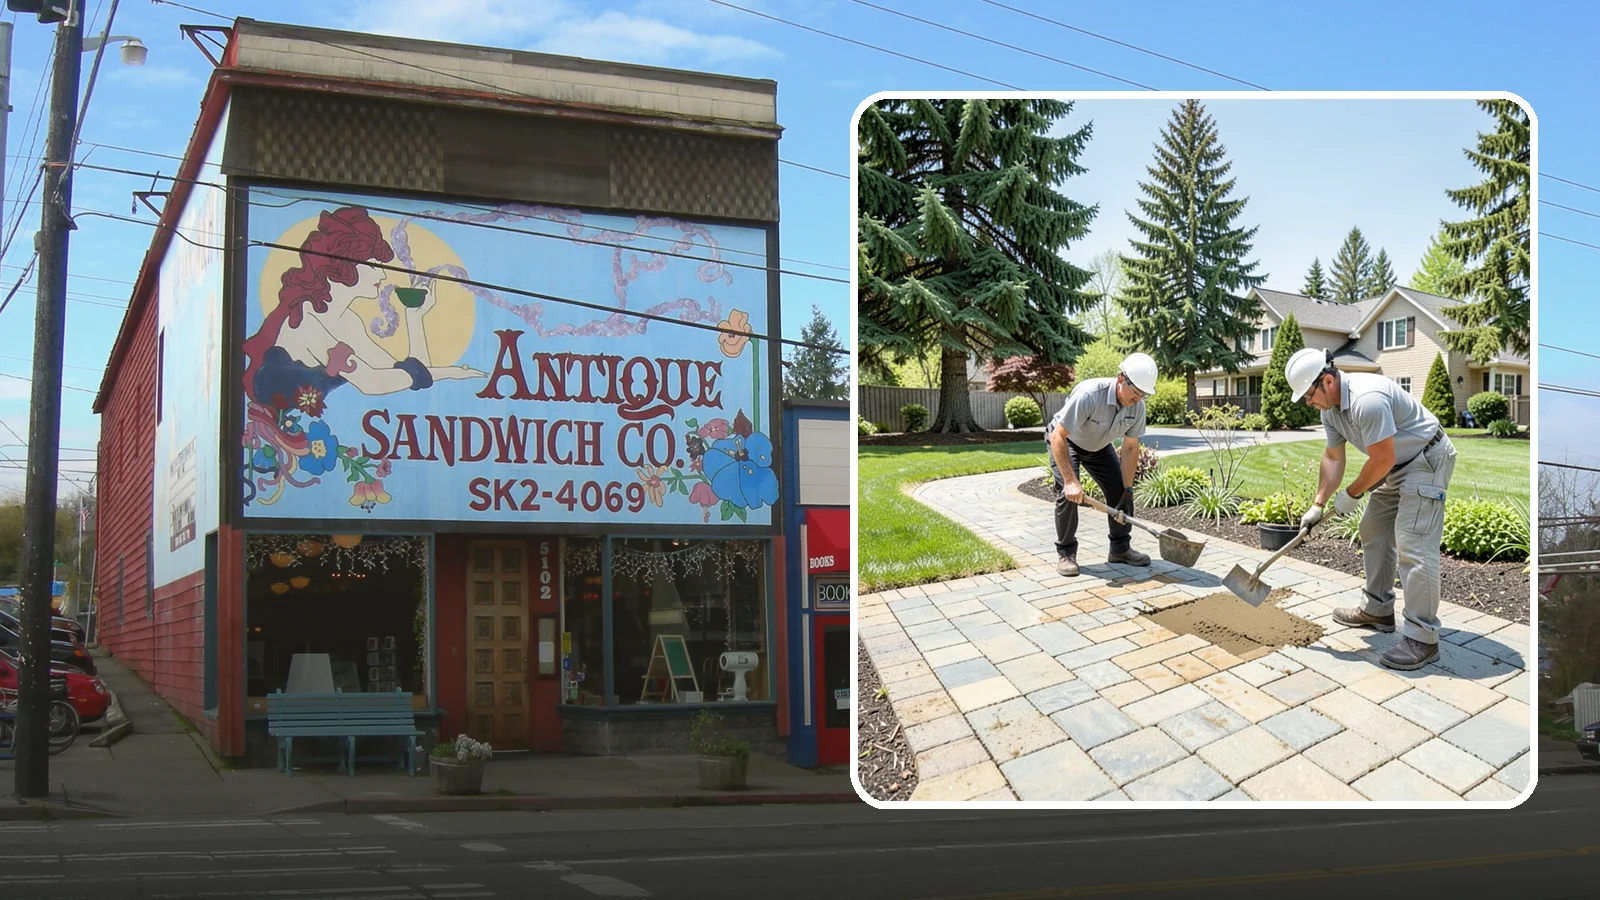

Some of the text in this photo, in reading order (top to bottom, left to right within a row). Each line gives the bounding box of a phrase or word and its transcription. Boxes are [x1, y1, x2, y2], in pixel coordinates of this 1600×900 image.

[476, 329, 724, 420] ANTIQUE
[361, 408, 685, 469] SANDWICH CO.
[468, 477, 646, 514] SK2-4069
[540, 541, 551, 600] 5102
[809, 555, 835, 569] BOOKS
